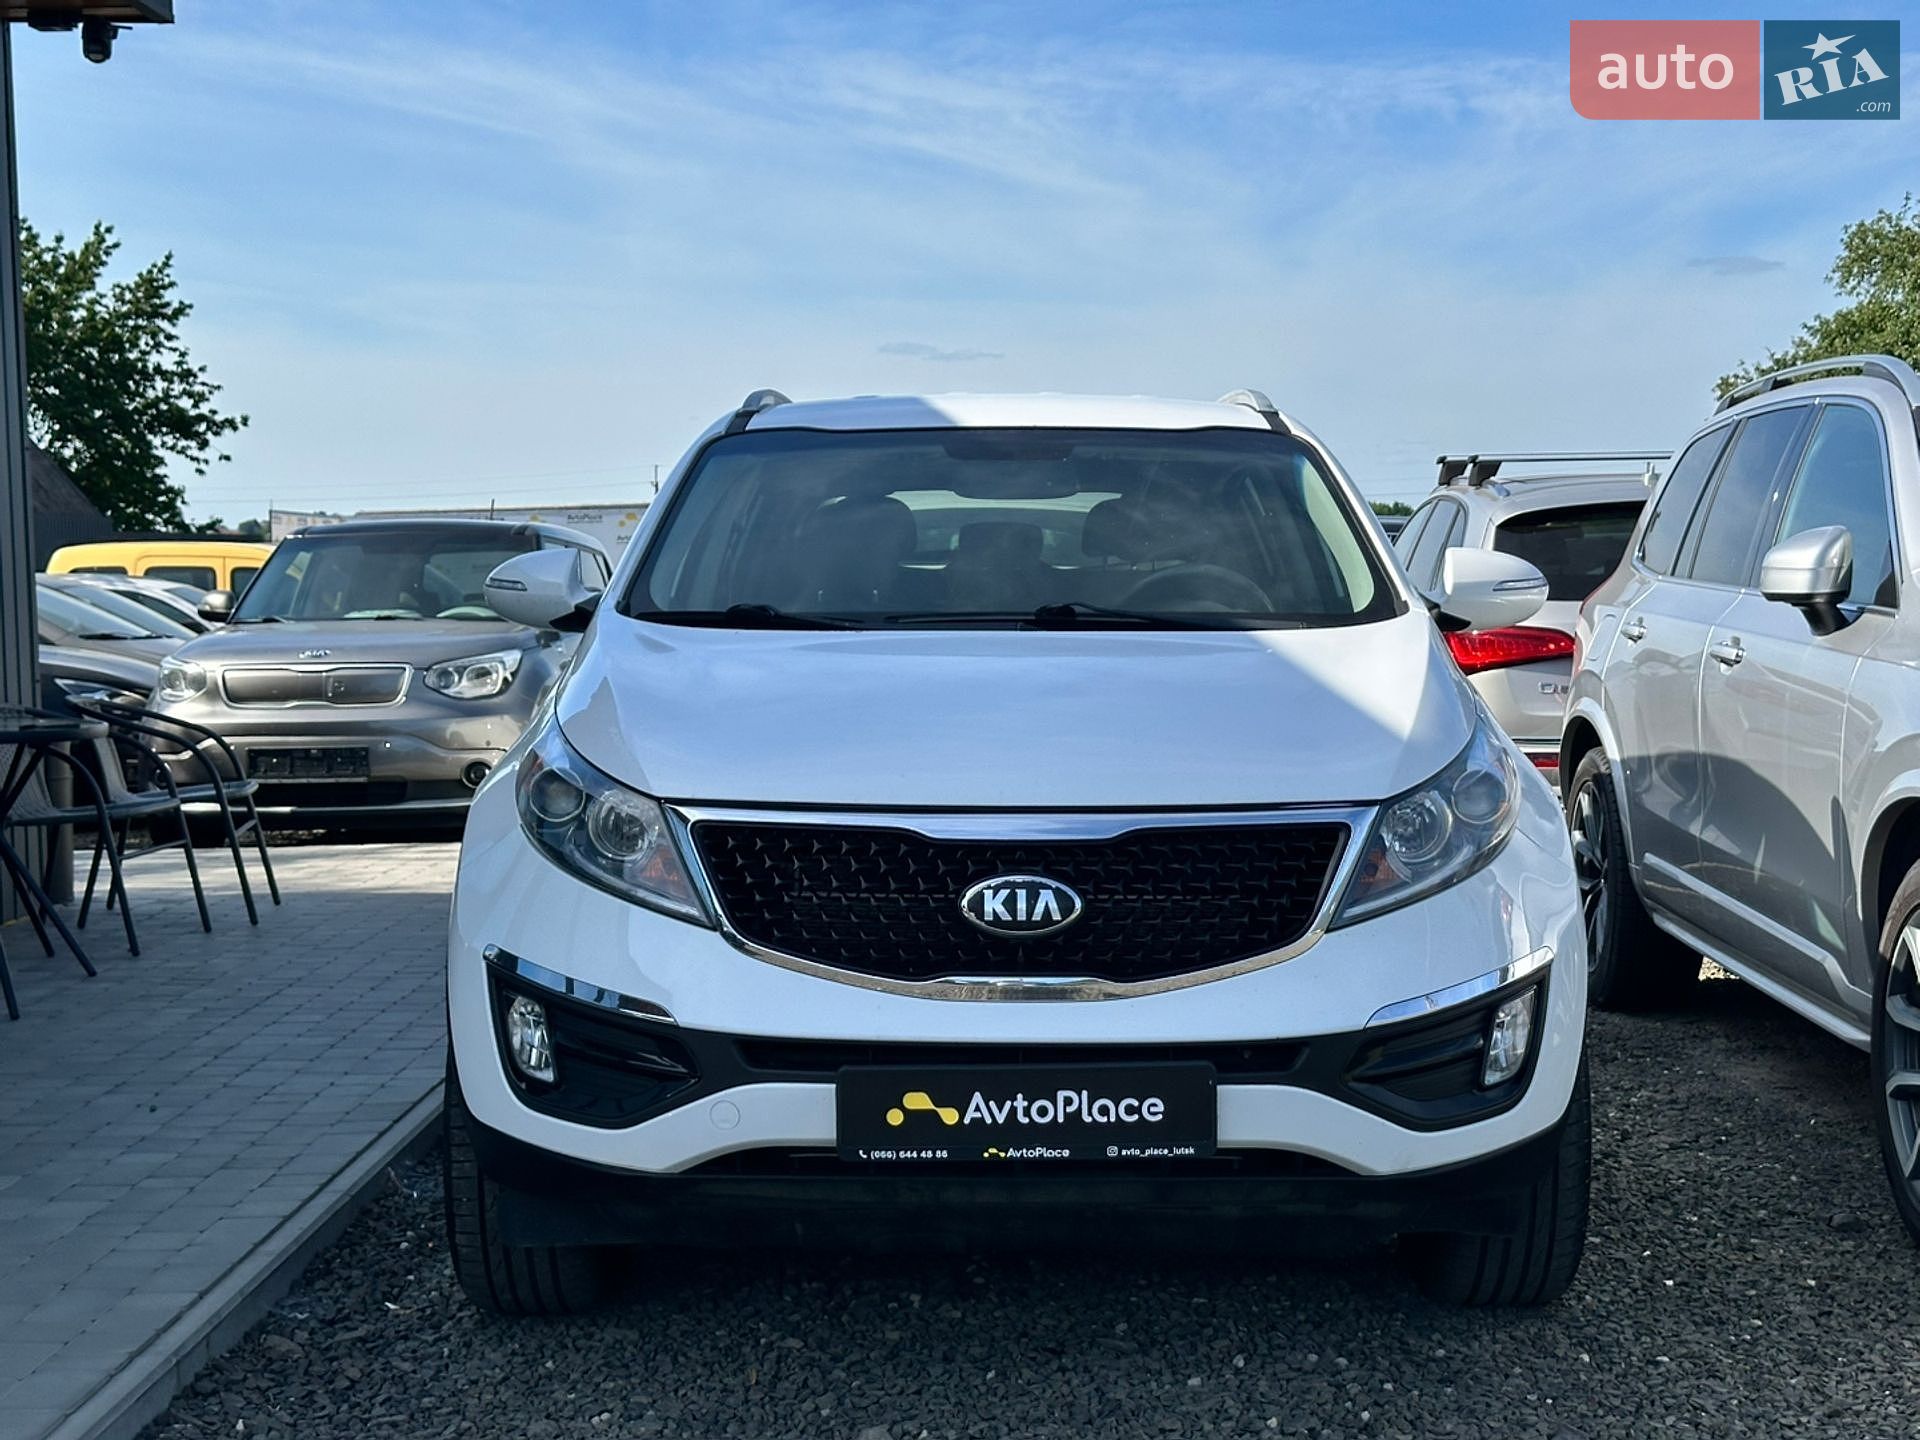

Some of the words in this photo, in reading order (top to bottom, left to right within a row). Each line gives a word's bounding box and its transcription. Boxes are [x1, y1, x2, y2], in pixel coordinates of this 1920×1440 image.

[983, 889, 1062, 921] KIA
[963, 1089, 1164, 1124] AvtoPlace
[1006, 1146, 1070, 1158] AvtoPlace
